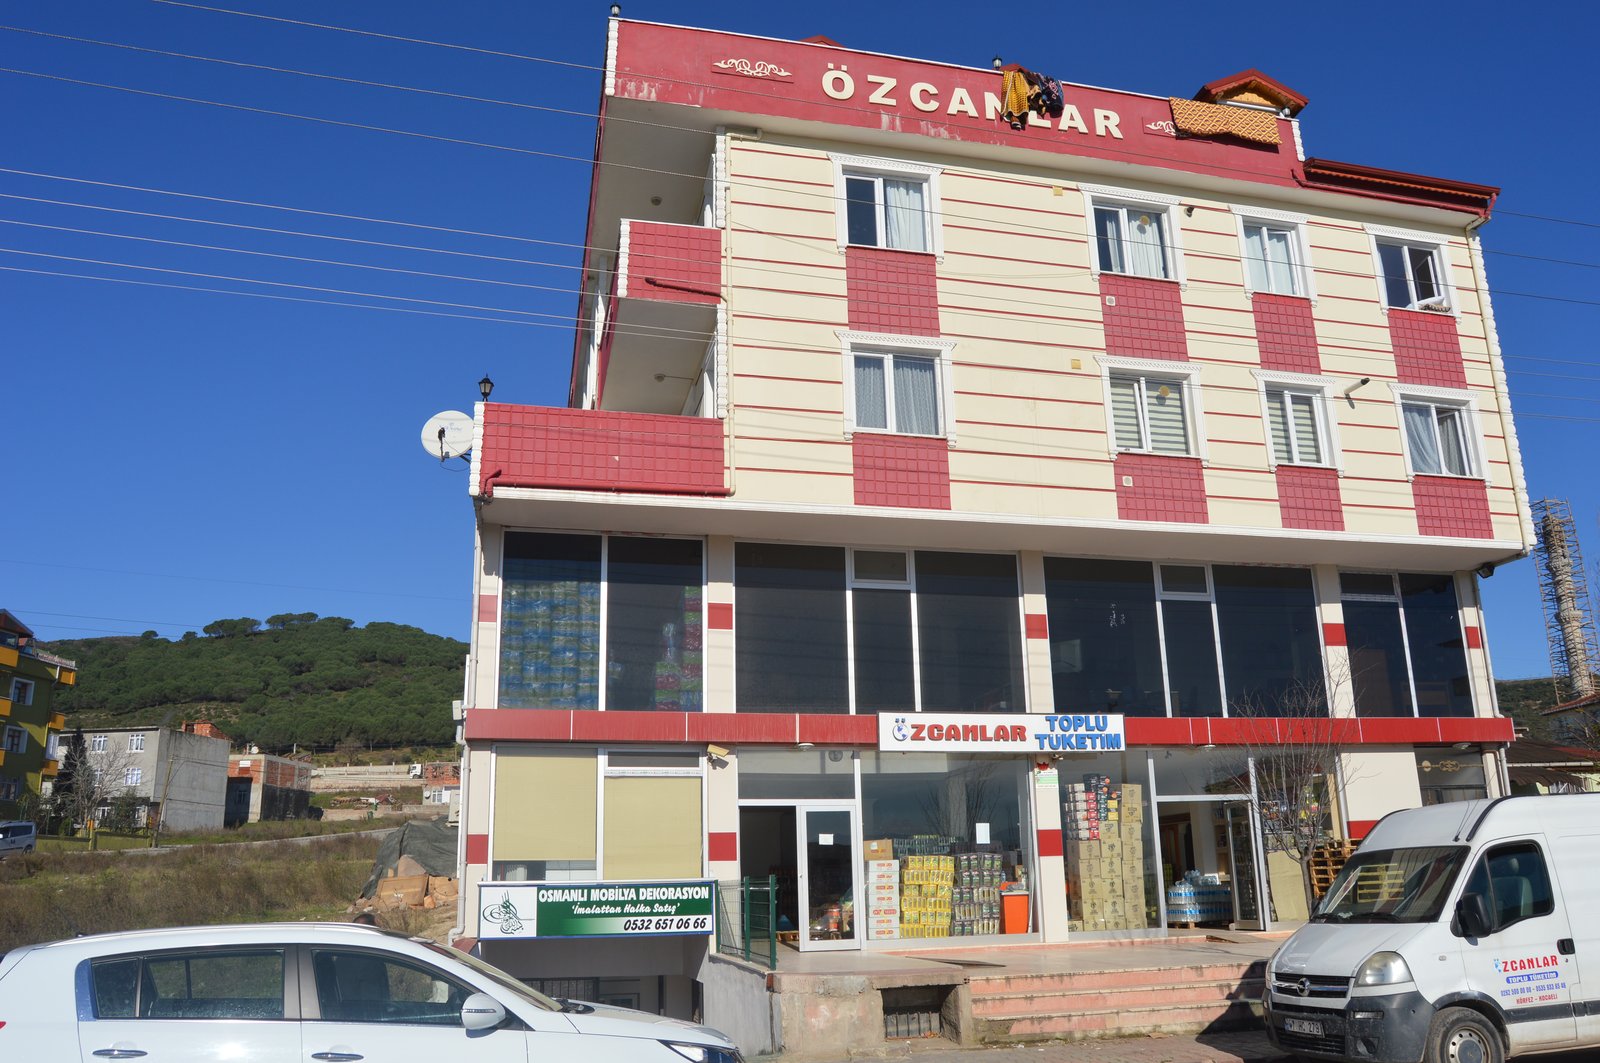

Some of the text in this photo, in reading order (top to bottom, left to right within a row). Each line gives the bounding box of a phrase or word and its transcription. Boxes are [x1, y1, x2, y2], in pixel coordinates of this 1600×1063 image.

[1045, 715, 1108, 732] TOPLU
[1035, 732, 1122, 750] TÜKETİM
[538, 885, 709, 903] OSMANLI MOBİLYA DEKORASYON
[623, 903, 651, 914] Halka
[623, 917, 707, 932] 0532 651 06 66
[1509, 975, 1529, 984] TOPLU
